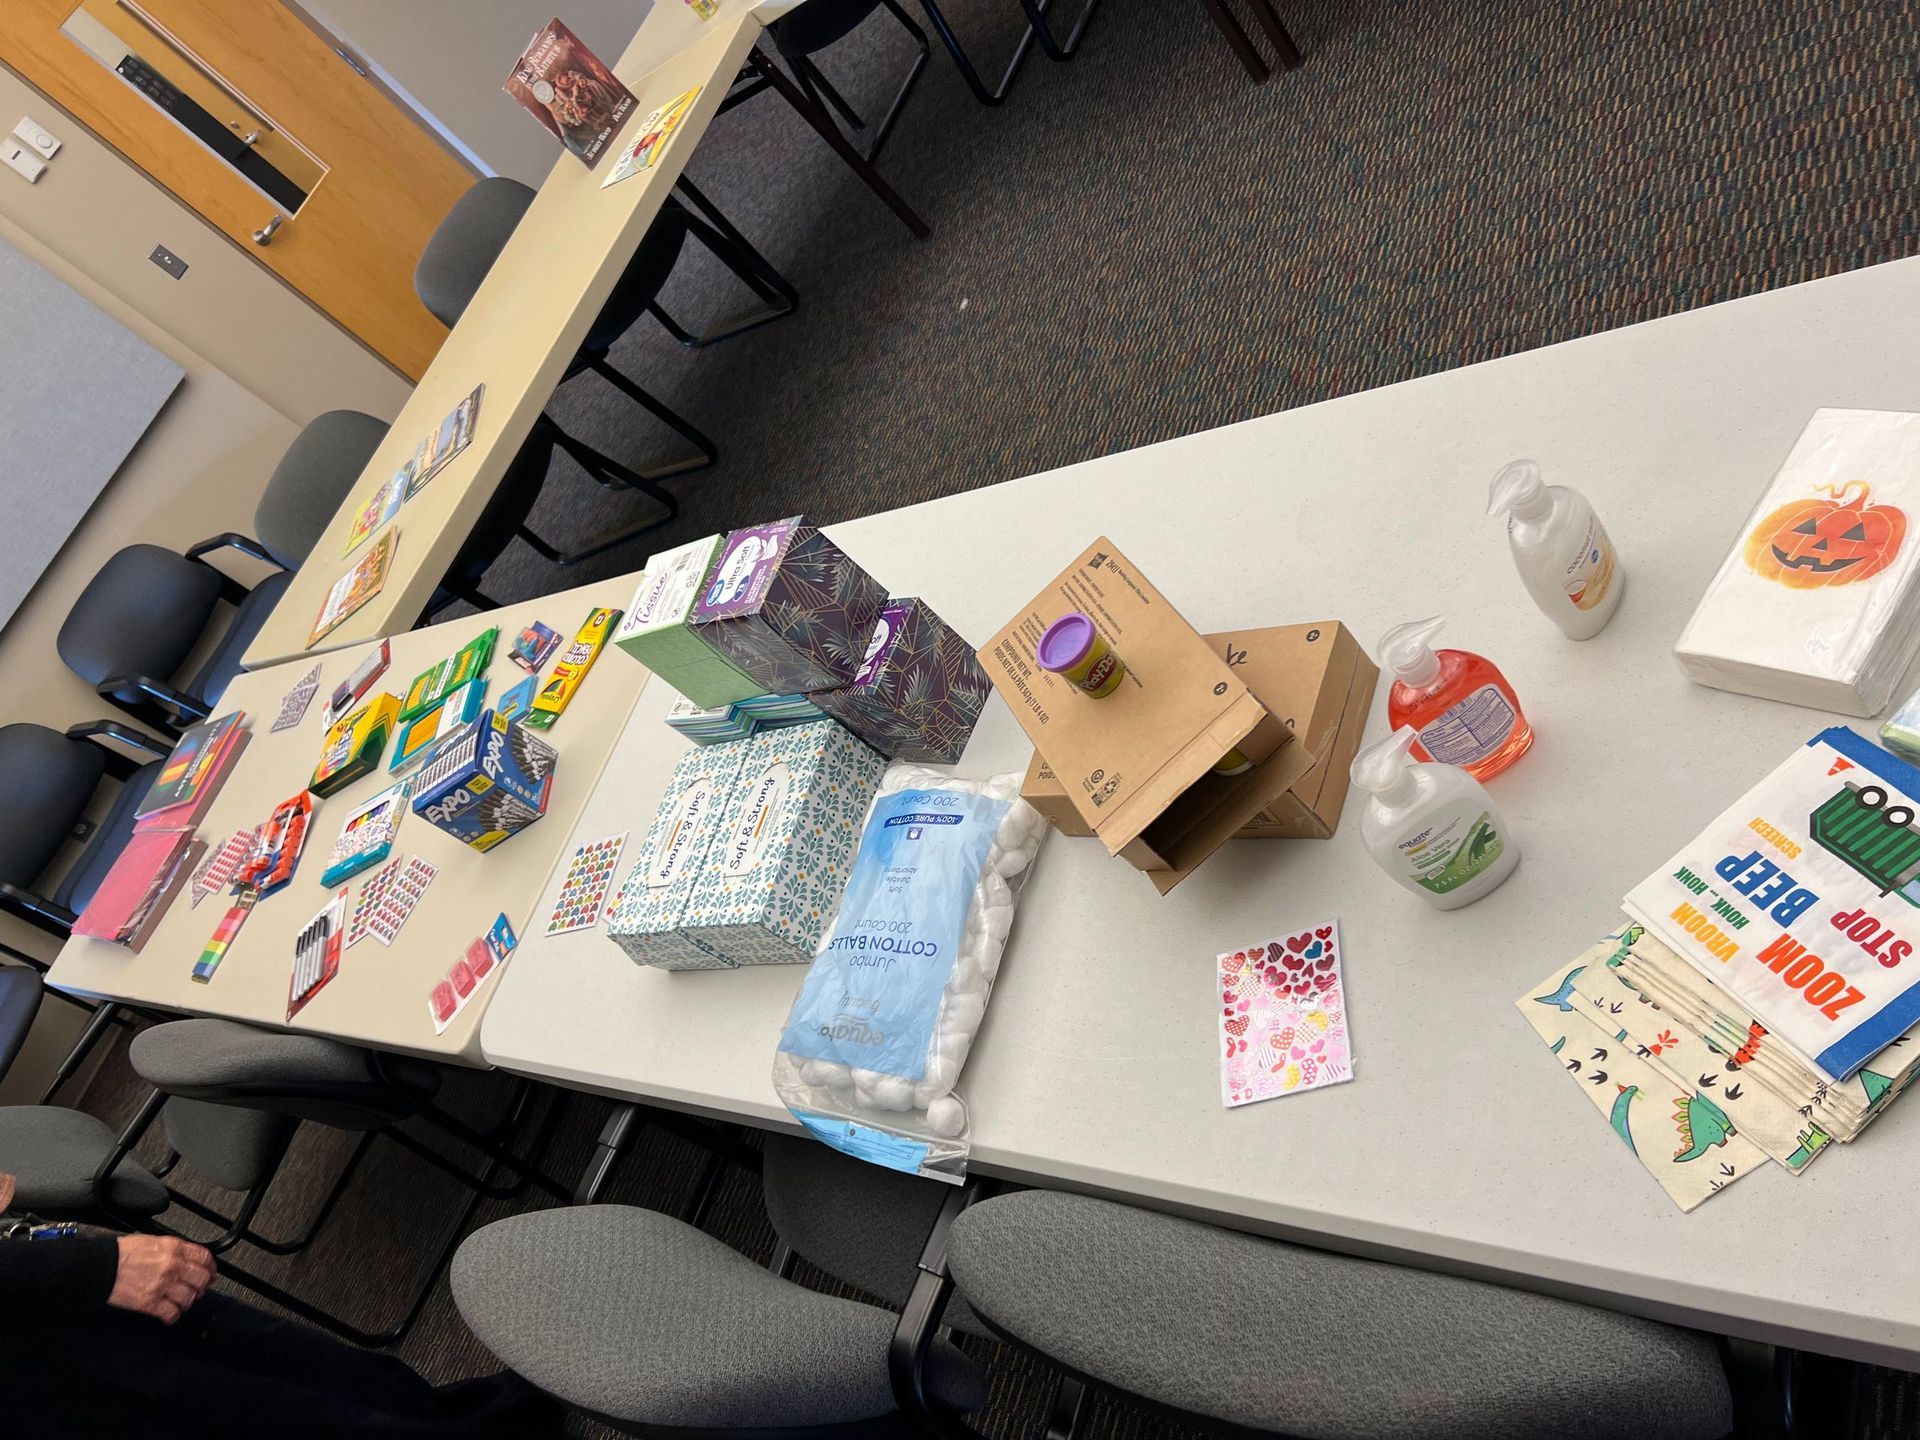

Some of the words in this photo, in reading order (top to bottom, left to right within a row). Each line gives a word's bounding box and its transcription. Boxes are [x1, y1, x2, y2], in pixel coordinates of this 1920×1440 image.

[725, 562, 741, 590] Ultra
[738, 545, 751, 565] Soft
[482, 730, 505, 780] EXPO
[424, 788, 472, 824] EXPO
[690, 790, 706, 818] Soft
[902, 796, 930, 806] Count
[934, 796, 959, 806] 200
[680, 818, 693, 832] &
[730, 838, 749, 870] Soft
[742, 823, 753, 838] &
[748, 777, 776, 828] Strong
[888, 816, 914, 825] COTTON
[1398, 828, 1432, 850] equate
[1411, 850, 1430, 862] Aloe
[1431, 839, 1451, 852] Vera
[1746, 816, 1802, 861] SCREECH
[660, 832, 688, 879] Strong
[1673, 865, 1710, 896] HONK
[1715, 850, 1820, 929] BEEP
[855, 919, 886, 931] Count
[1710, 896, 1751, 930] HONK
[888, 922, 912, 934] 200
[1670, 902, 1741, 964] VROOM
[1830, 908, 1914, 970] STOP
[828, 936, 867, 950] BALLS
[870, 936, 938, 957] COTTON
[850, 955, 897, 972] Jumbo
[1754, 932, 1867, 1022] ZOOM
